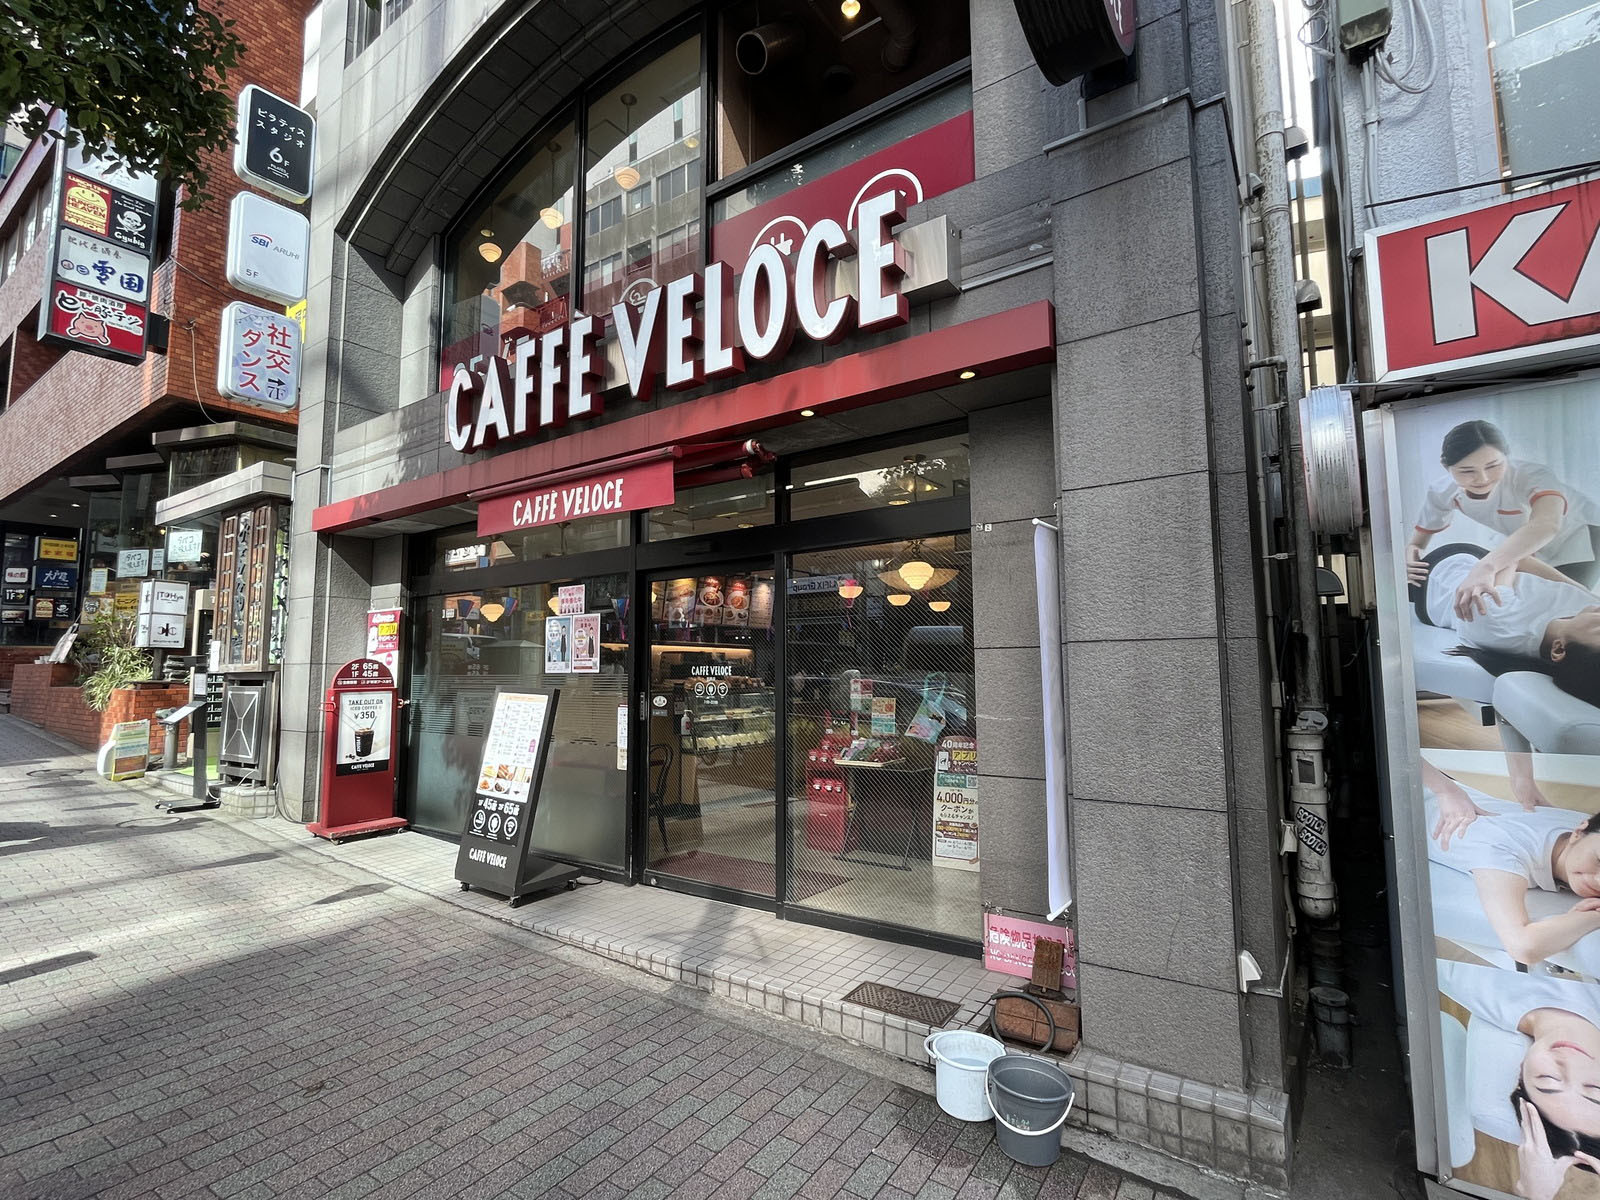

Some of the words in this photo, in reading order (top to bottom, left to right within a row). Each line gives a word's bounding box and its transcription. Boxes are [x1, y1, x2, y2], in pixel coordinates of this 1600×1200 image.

[256, 119, 305, 148] スタジオ
[257, 107, 305, 137] ピラティス
[67, 195, 106, 213] HUNGRY
[67, 201, 106, 218] HEAVEN
[114, 231, 146, 249] Gyubig
[250, 235, 271, 248] SBI
[272, 245, 301, 261] ARUHI
[245, 268, 260, 279] 5F
[1425, 198, 1600, 346] K
[612, 190, 909, 399] VELOCE
[239, 328, 265, 392] ダンス
[265, 323, 292, 375] 社交
[267, 385, 287, 401] 7F
[561, 478, 624, 518] VELOCE
[43, 570, 69, 583] 大戸屋
[351, 663, 360, 671] 2F
[709, 665, 732, 676] VELOCE
[353, 711, 376, 720] ¥350
[1296, 808, 1326, 835] SCOTCH
[1299, 828, 1328, 855] SCOTCH
[486, 850, 508, 870] VELOCE
